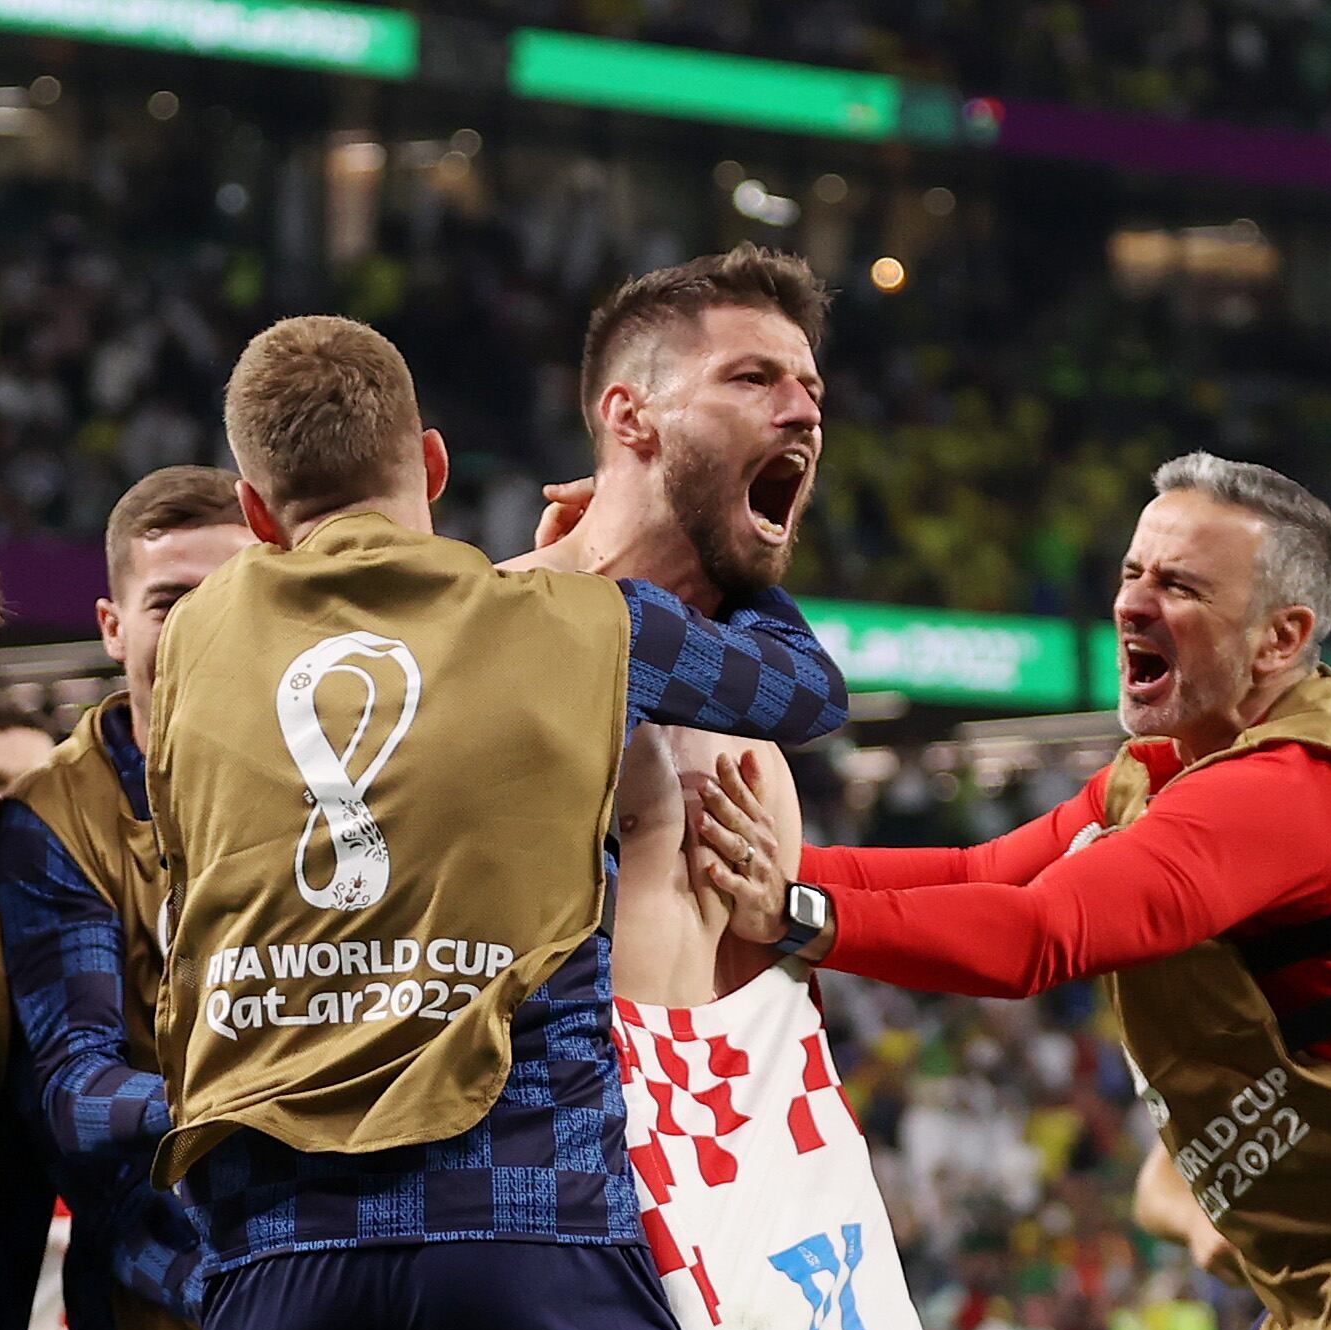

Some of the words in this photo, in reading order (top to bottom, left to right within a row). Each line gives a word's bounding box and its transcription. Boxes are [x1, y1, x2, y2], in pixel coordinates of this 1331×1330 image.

[269, 939, 420, 978] WORLD
[427, 938, 513, 979] CUP
[1174, 1115, 1239, 1184] ORLD
[1231, 1066, 1288, 1125] CUP
[492, 1167, 557, 1181] HRVATSKA
[492, 1180, 557, 1194] HRVATSKA
[493, 1193, 557, 1206] HRVATSKA
[493, 1206, 557, 1221] HRVATSKA
